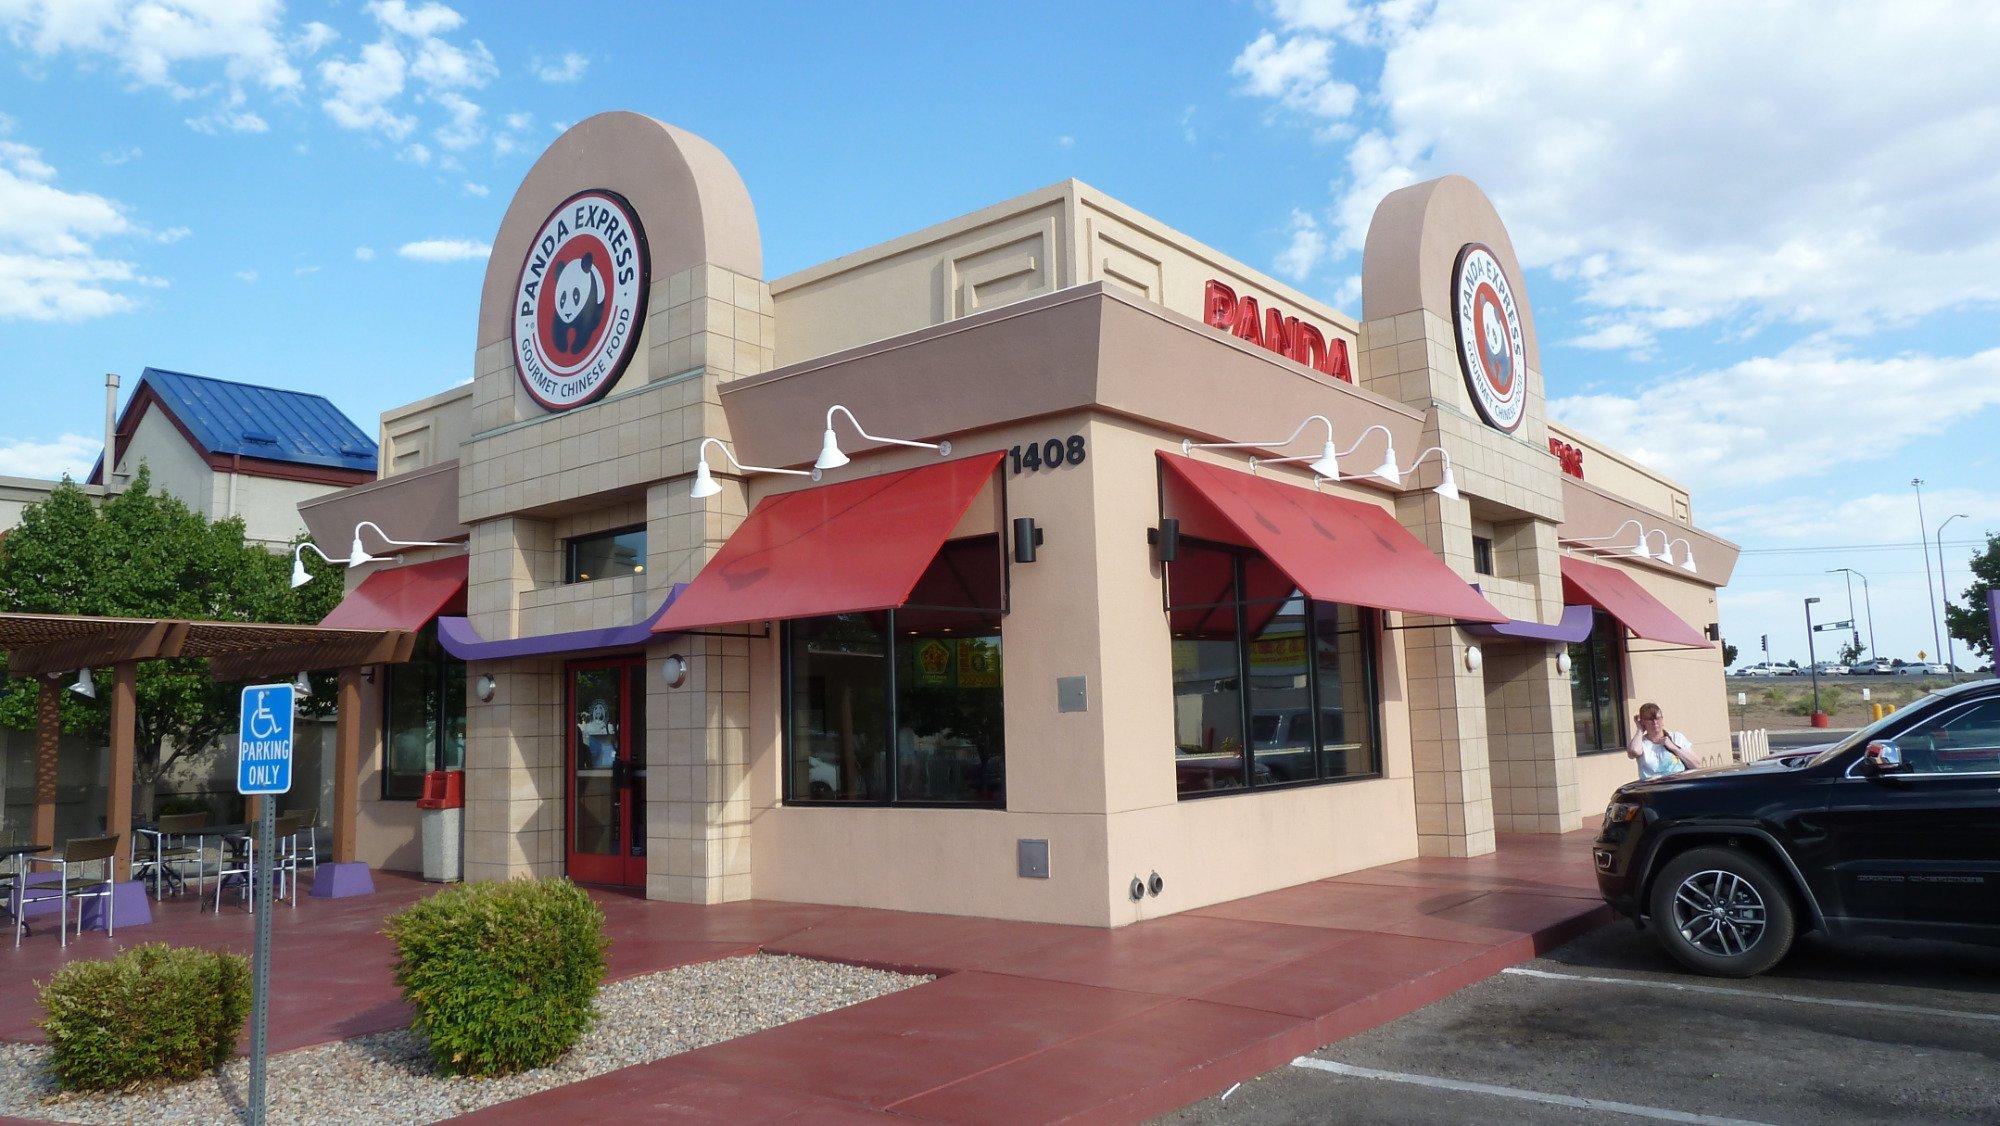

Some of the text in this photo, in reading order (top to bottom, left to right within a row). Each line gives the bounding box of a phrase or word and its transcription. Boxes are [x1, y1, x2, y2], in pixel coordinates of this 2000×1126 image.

[521, 205, 634, 317] PANDA EXPRESS
[1204, 279, 1353, 385] PANDA
[1463, 257, 1521, 356] PANDA EXPRESS
[522, 308, 630, 398] GOURMET CHINESE FOOD
[1009, 434, 1086, 475] 1408
[242, 739, 289, 762] PARKING
[248, 764, 280, 786] ONLY
